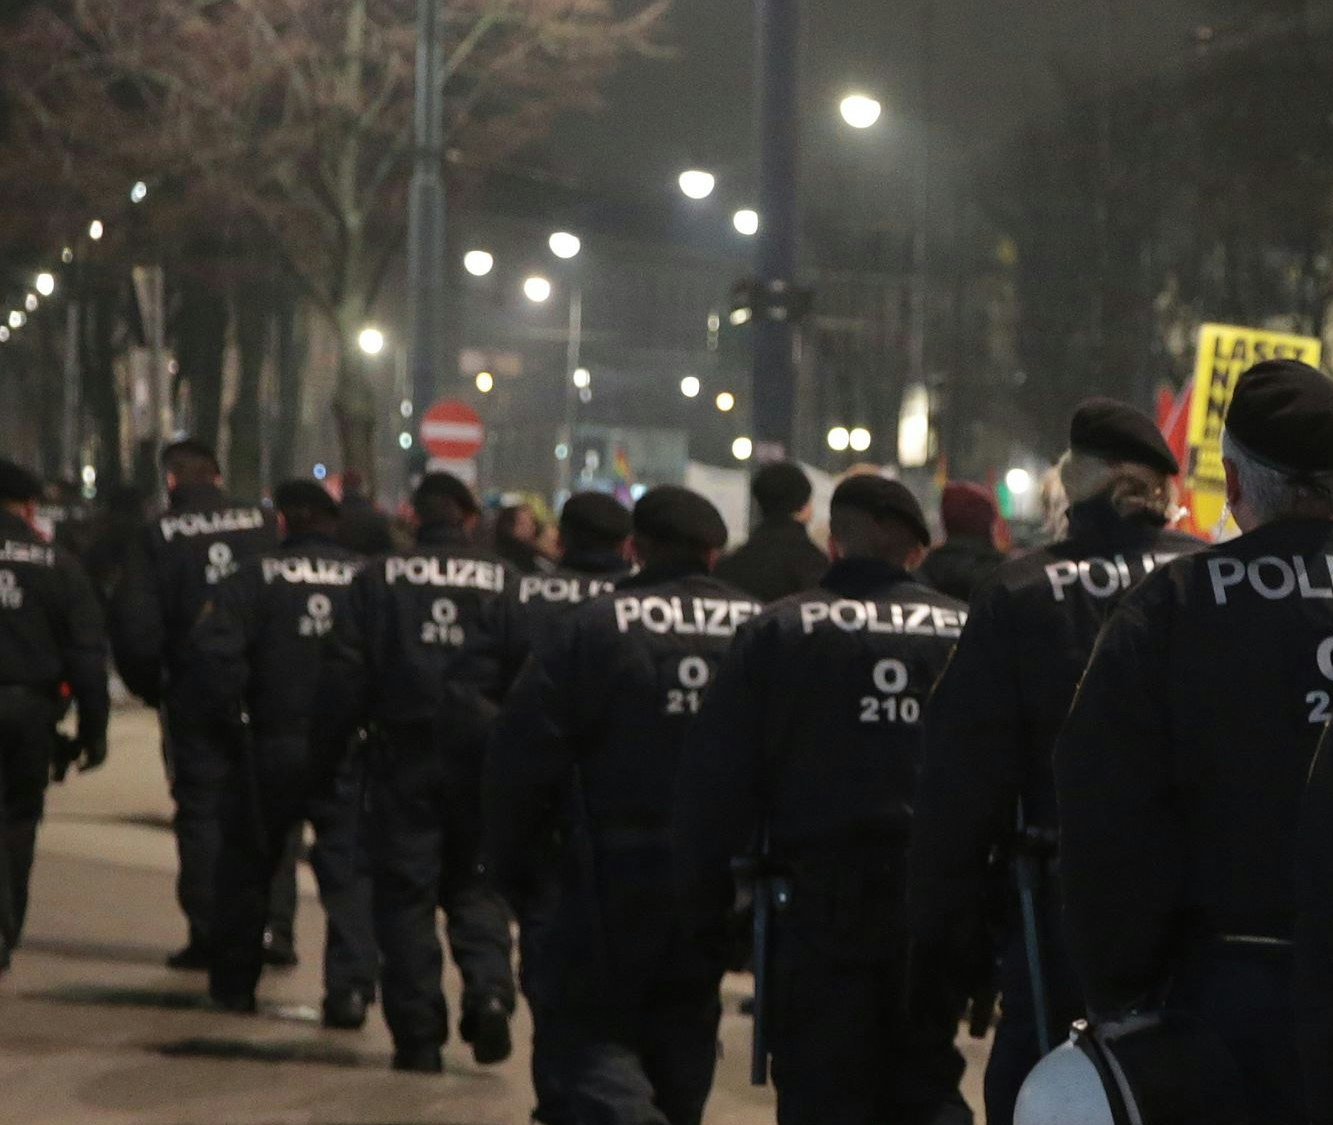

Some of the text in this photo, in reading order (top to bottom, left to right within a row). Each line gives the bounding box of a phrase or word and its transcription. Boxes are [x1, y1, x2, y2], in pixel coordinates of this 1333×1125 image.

[386, 556, 505, 593] POLIZEI
[614, 596, 763, 636] POLIZE
[666, 688, 701, 714] 21
[859, 697, 920, 723] 210
